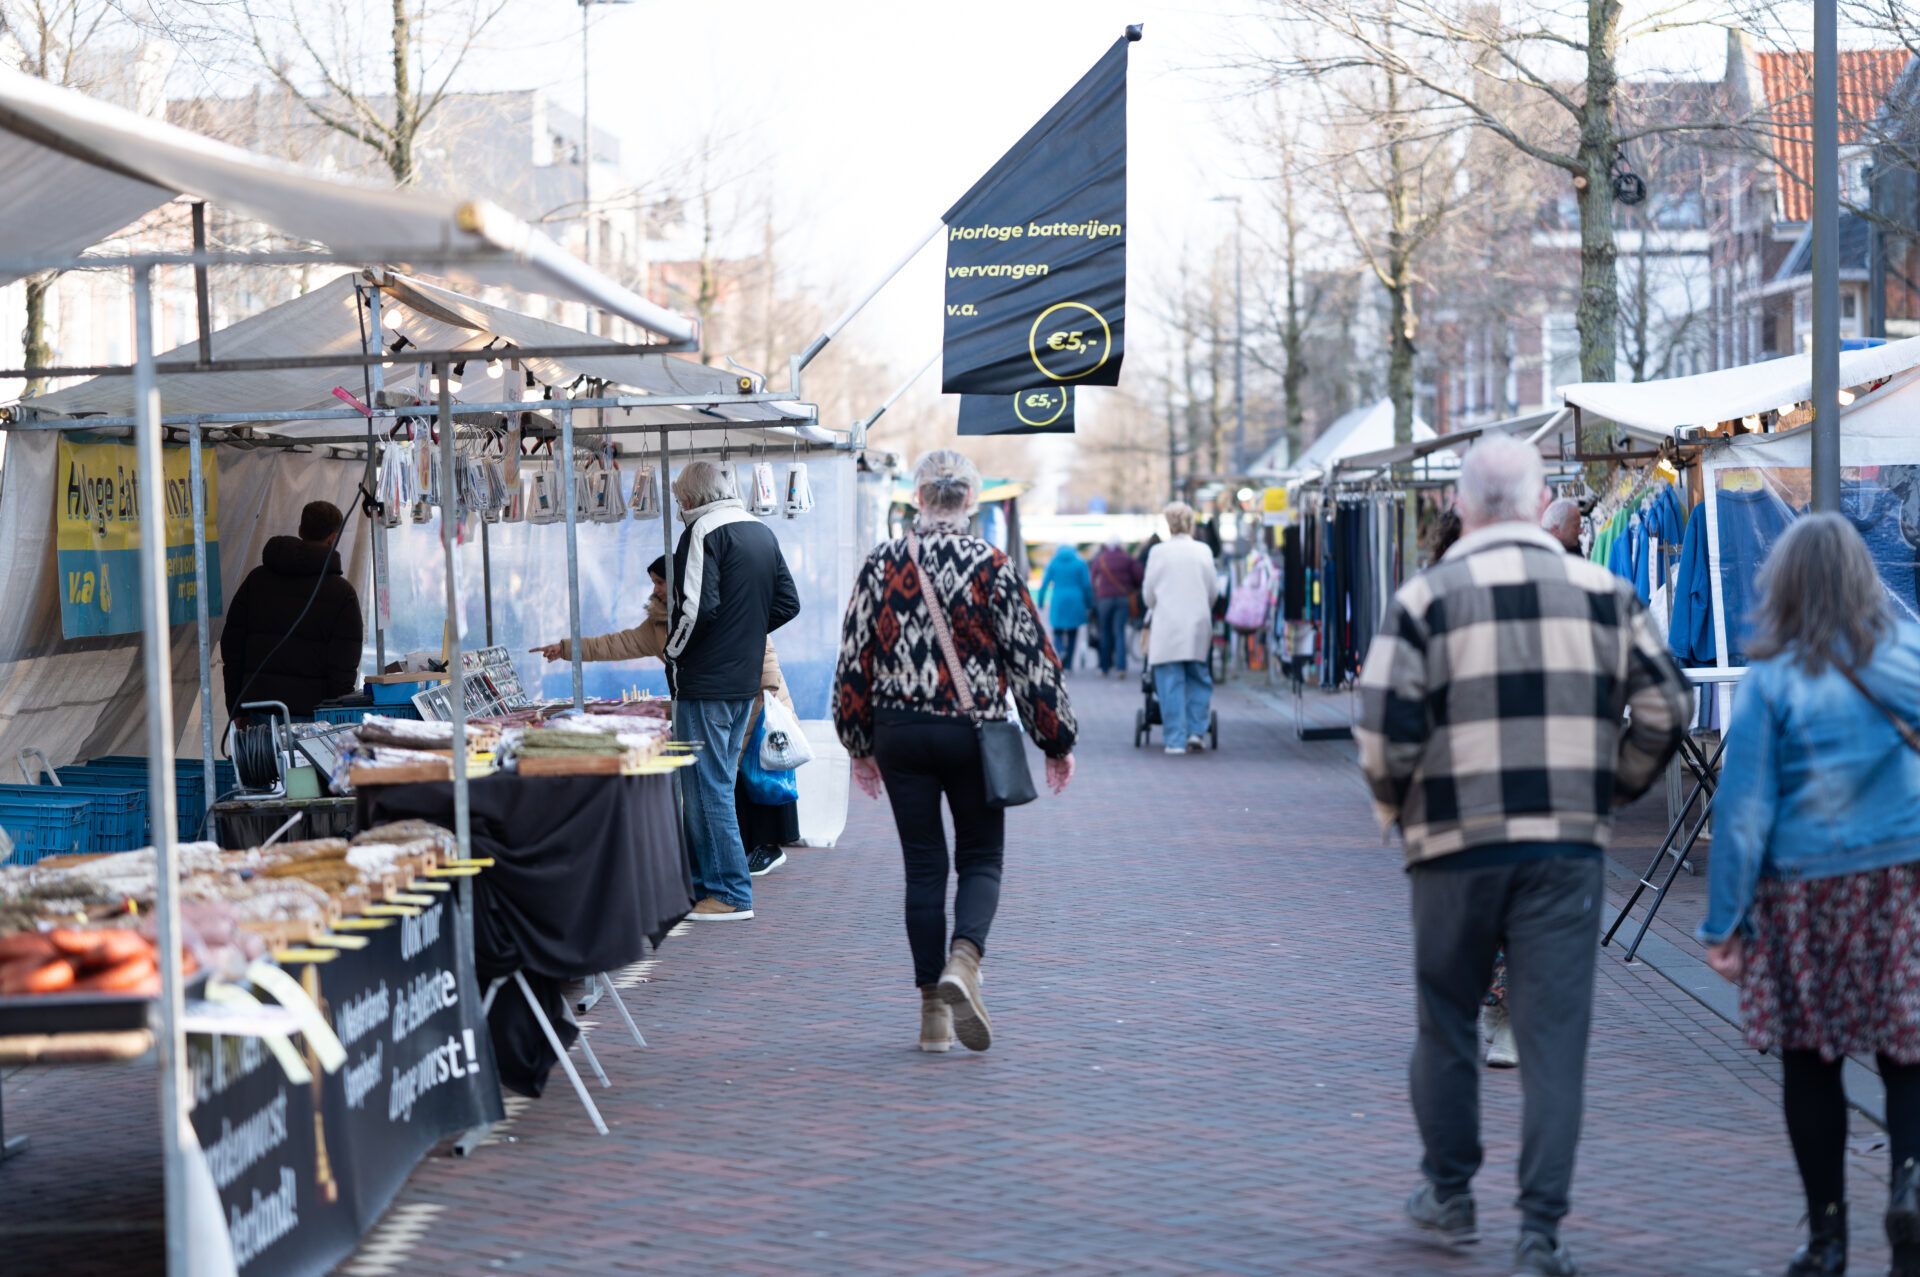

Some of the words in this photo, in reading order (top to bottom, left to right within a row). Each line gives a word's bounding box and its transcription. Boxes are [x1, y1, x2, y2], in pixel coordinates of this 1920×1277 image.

[949, 223, 1024, 241] Horloge
[1027, 219, 1122, 240] batterijen
[947, 262, 1049, 280] vervangen
[946, 303, 979, 316] v.a.
[1045, 331, 1098, 355] €5,-
[1024, 393, 1058, 409] €5,-
